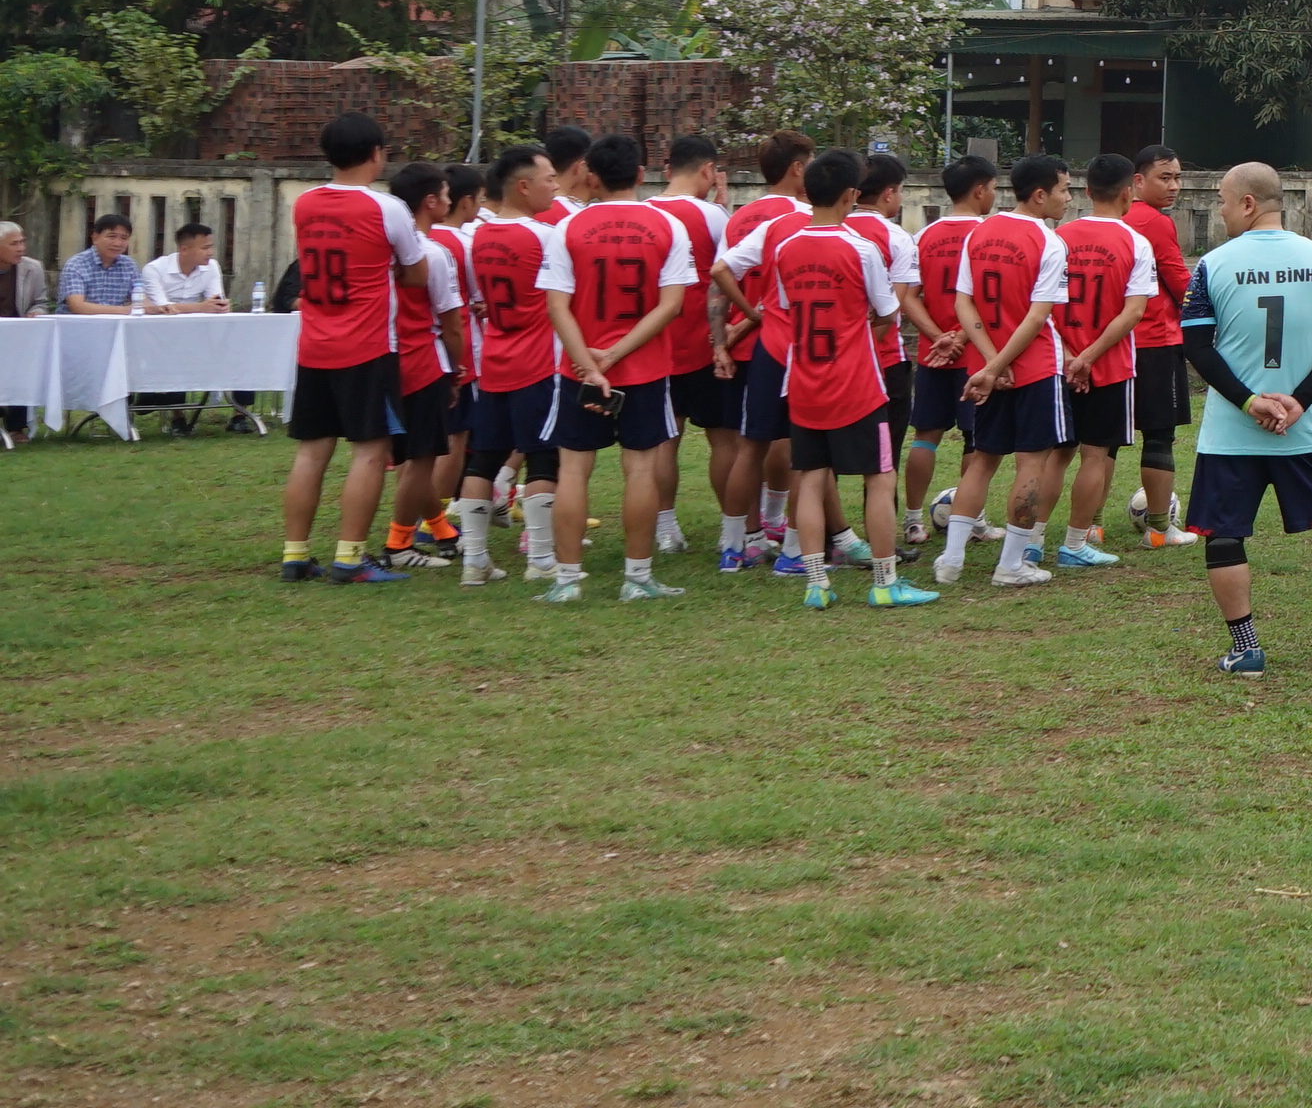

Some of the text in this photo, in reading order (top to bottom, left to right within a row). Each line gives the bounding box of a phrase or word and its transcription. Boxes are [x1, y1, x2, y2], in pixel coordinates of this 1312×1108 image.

[303, 248, 348, 305] 28
[593, 258, 646, 321] 13
[982, 269, 1002, 329] 9
[1064, 273, 1103, 329] 21
[1235, 269, 1269, 285] VĂN
[792, 300, 836, 363] 16
[1258, 296, 1284, 368] 1
